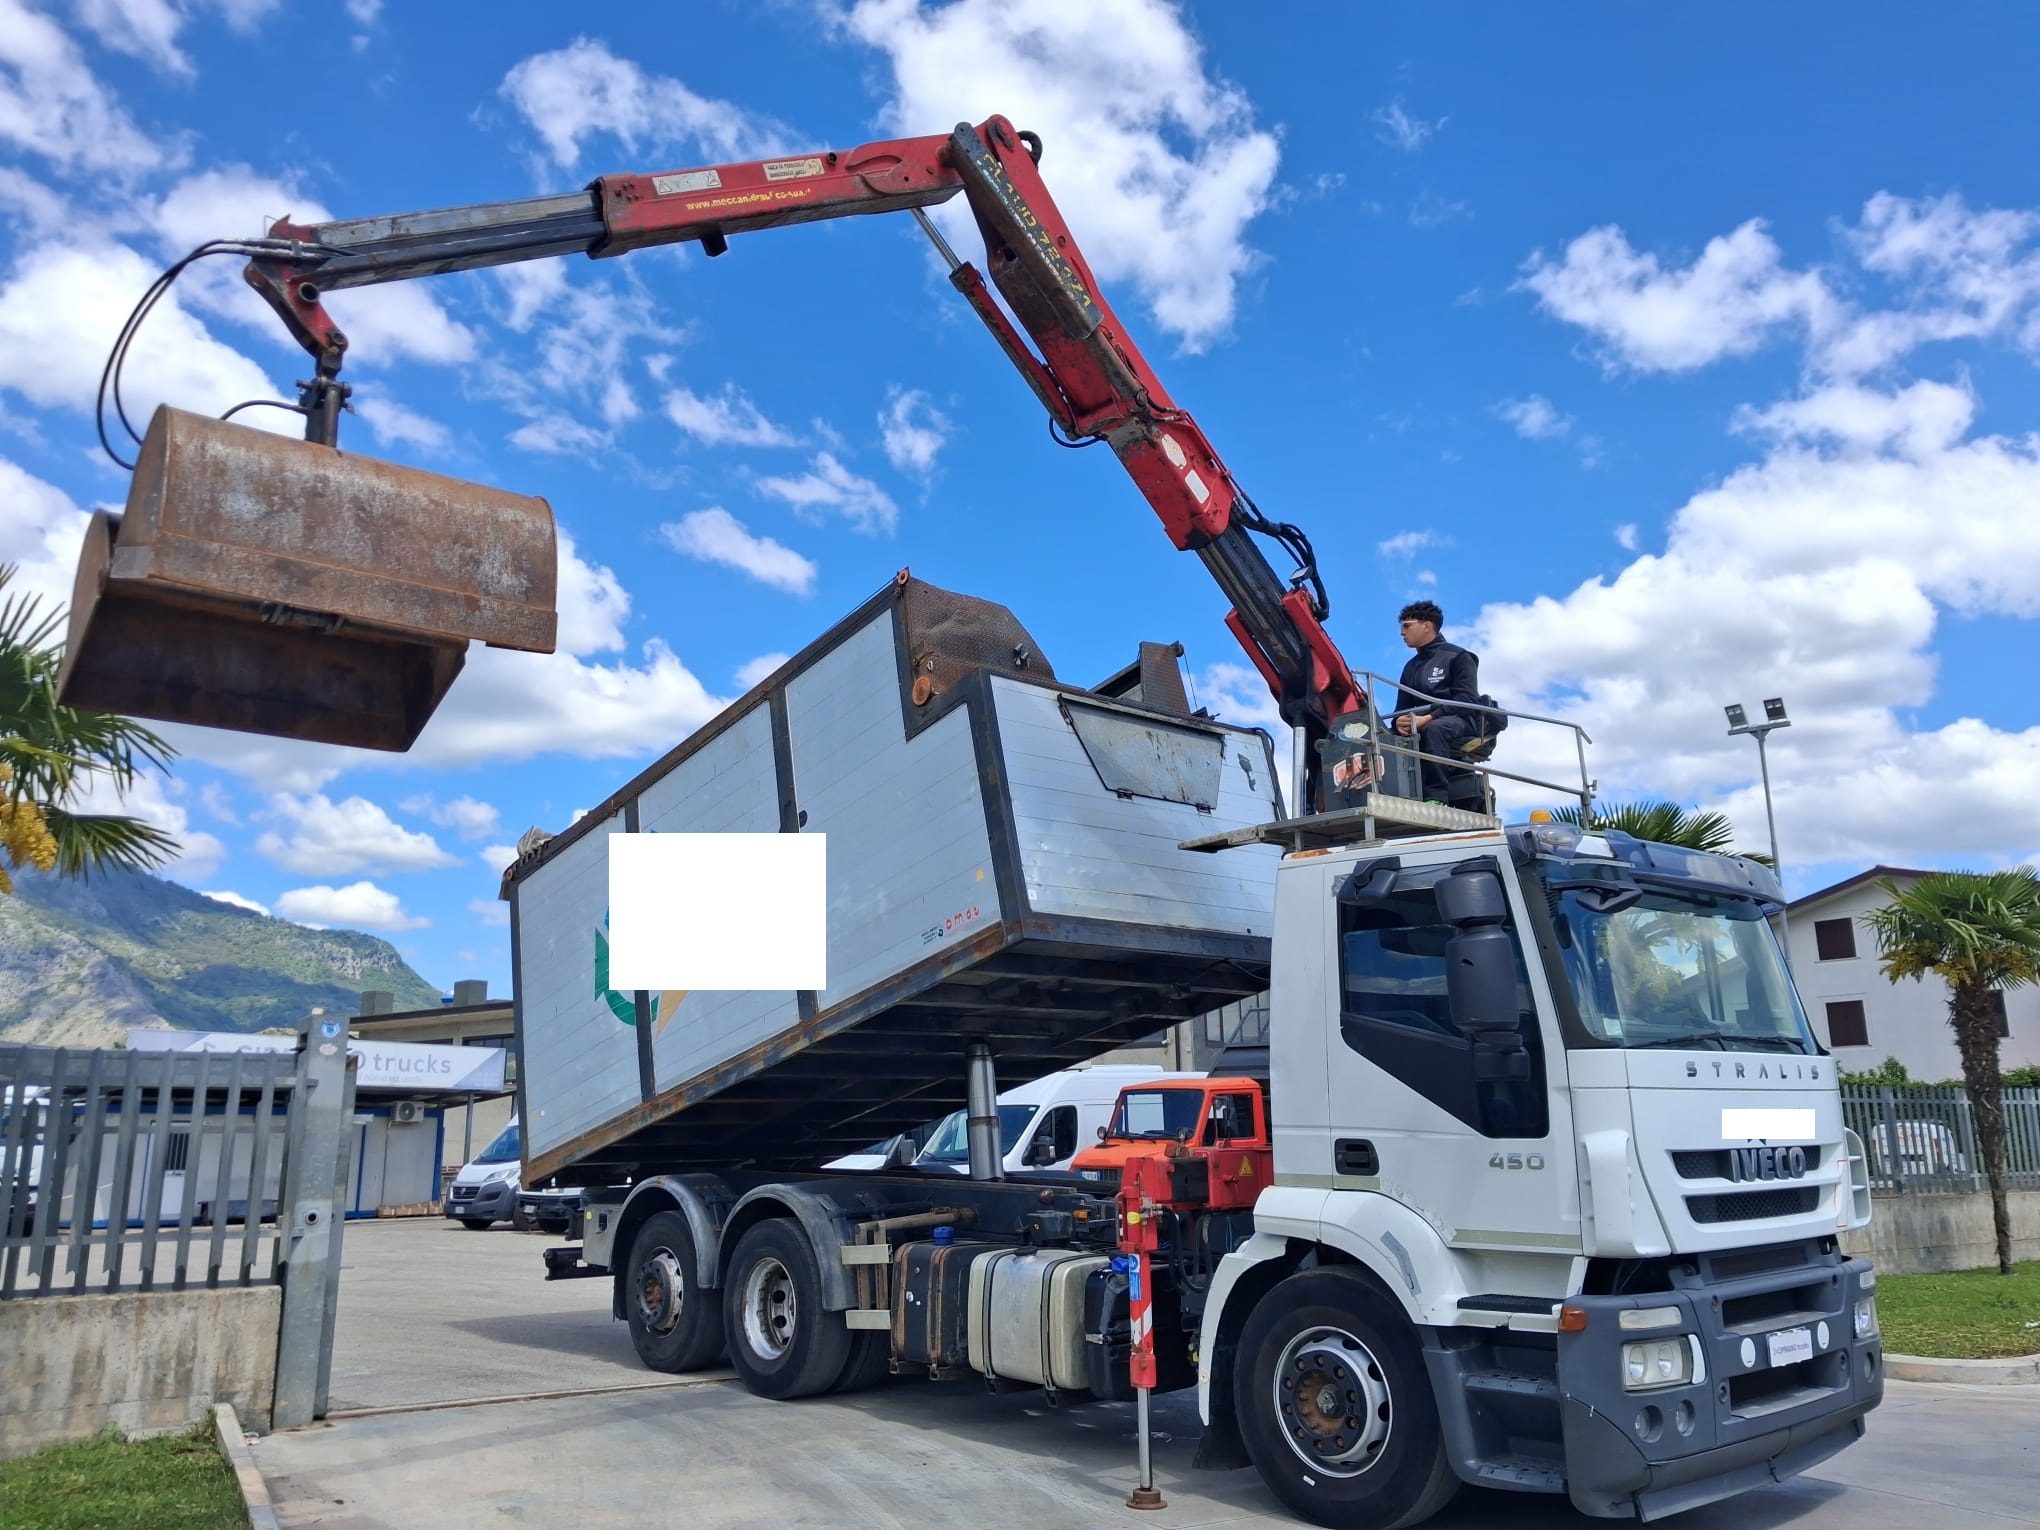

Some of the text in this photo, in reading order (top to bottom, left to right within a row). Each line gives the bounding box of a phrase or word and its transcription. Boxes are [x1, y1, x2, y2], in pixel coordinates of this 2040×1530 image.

[372, 1052, 451, 1073] trucks
[1686, 1060, 1820, 1081] STRALIS
[1489, 1152, 1545, 1171] 450
[1727, 1146, 1807, 1183] IVECO
